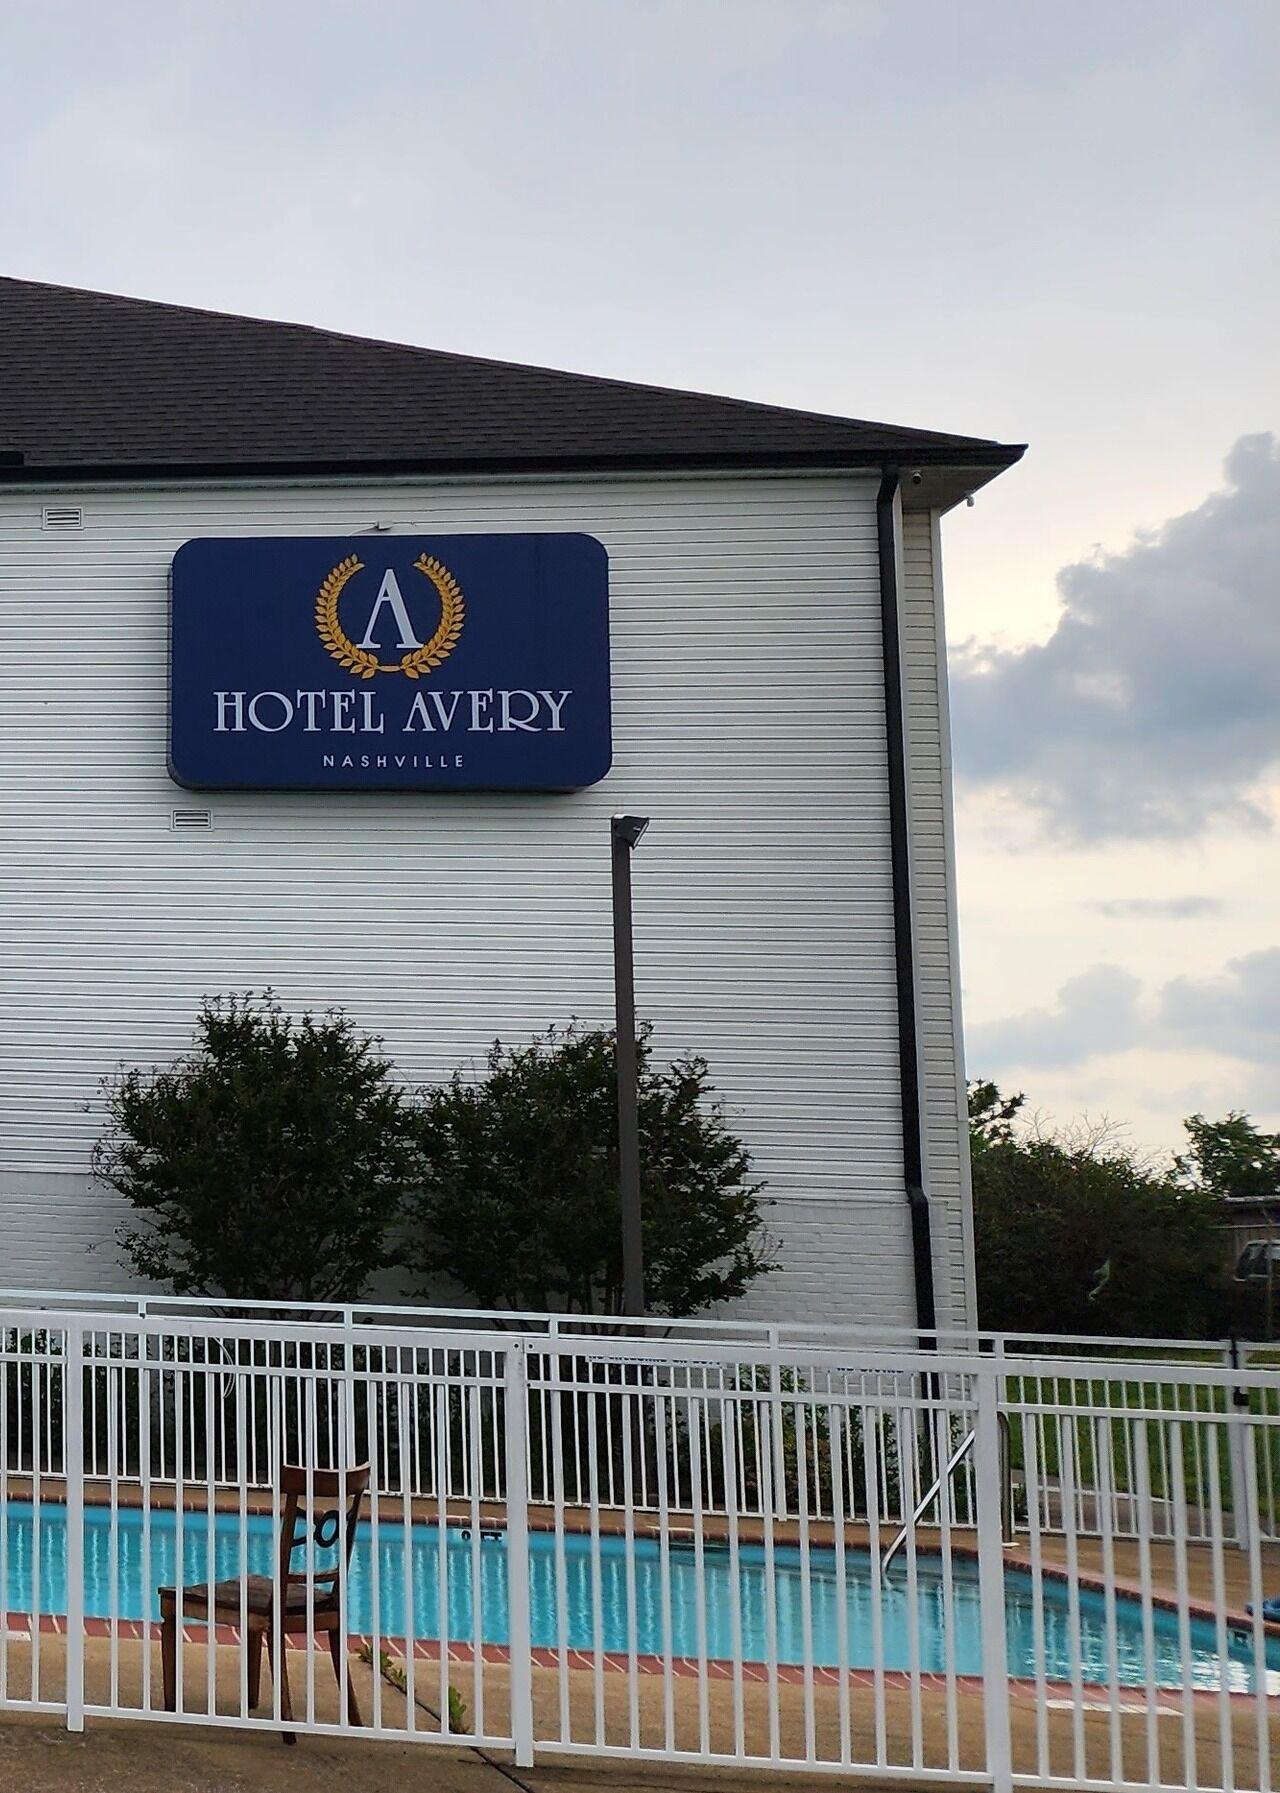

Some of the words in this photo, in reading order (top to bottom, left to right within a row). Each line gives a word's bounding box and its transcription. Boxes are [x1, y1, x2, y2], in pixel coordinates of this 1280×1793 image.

[355, 568, 425, 650] A
[213, 689, 384, 735] HOTEL
[402, 687, 573, 733] AVERY
[323, 754, 465, 769] NASHVILLE
